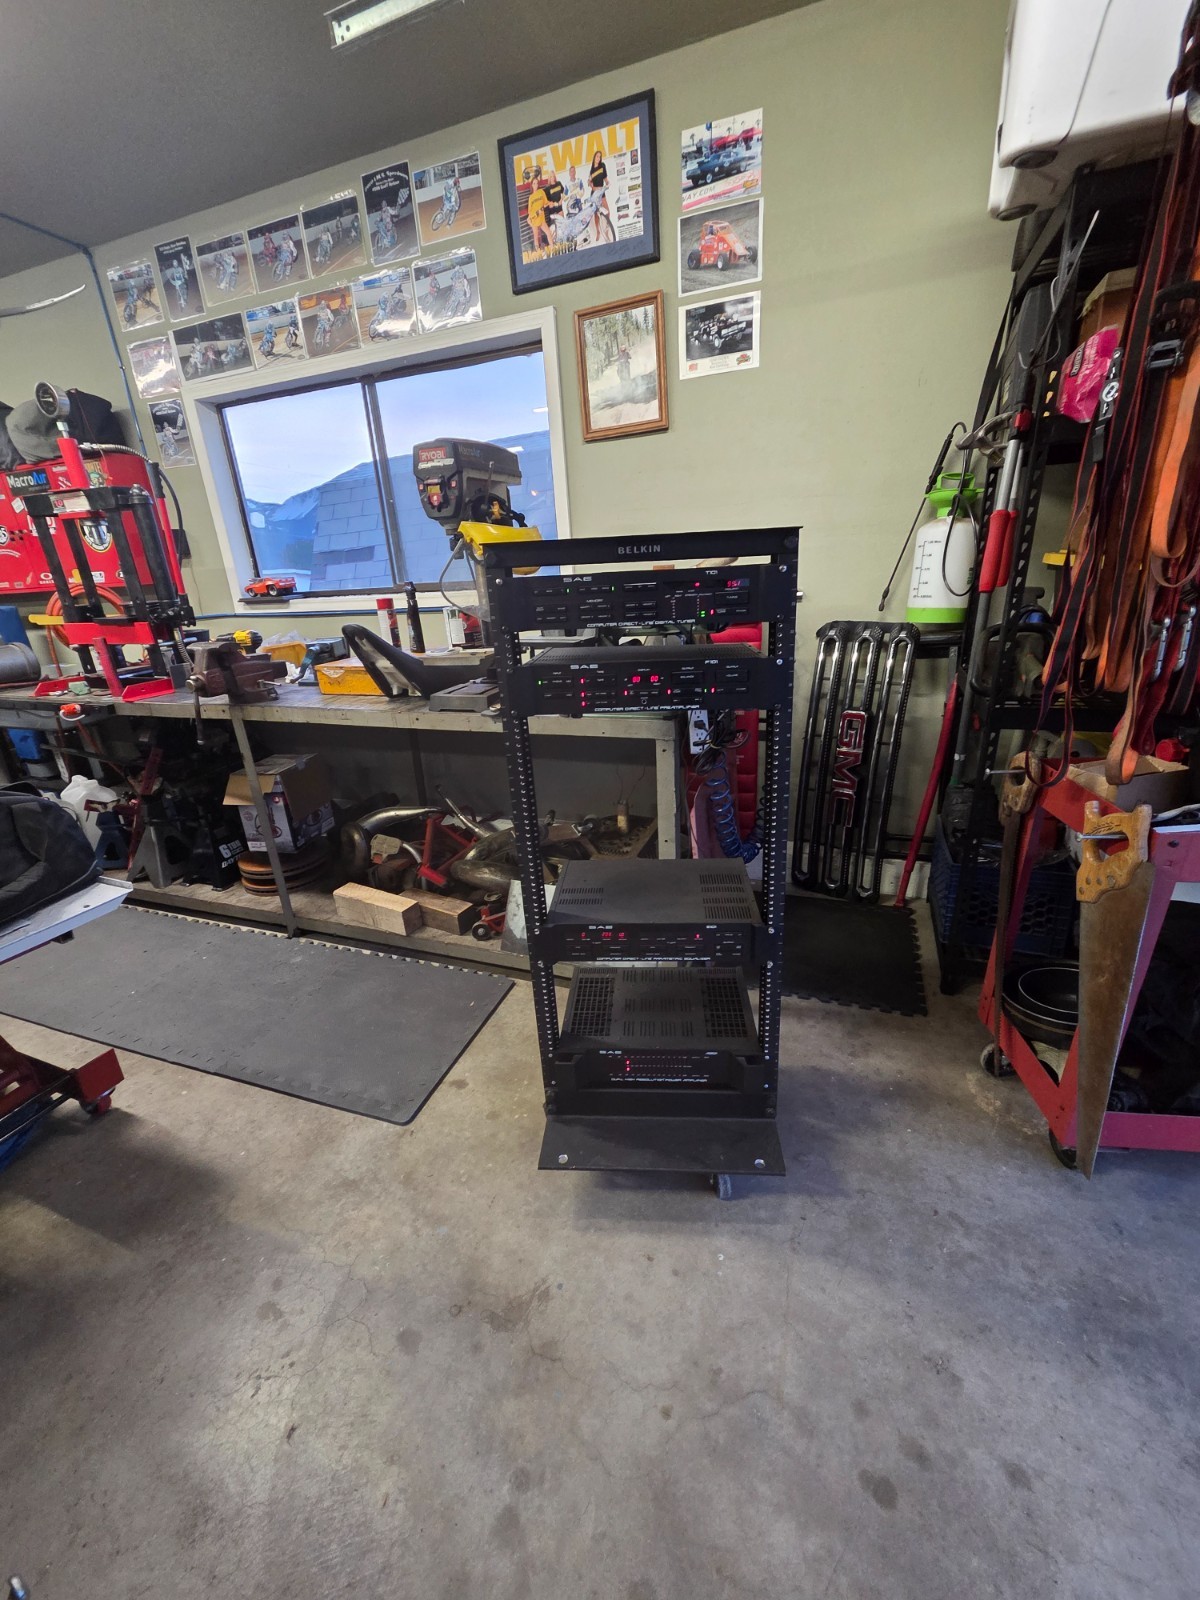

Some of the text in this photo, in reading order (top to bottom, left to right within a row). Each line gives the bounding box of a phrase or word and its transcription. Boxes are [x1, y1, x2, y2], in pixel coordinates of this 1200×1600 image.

[6, 471, 47, 489] MacroAir
[617, 544, 661, 555] BELKIN
[829, 709, 867, 828] GMC
[218, 844, 232, 859] 6
